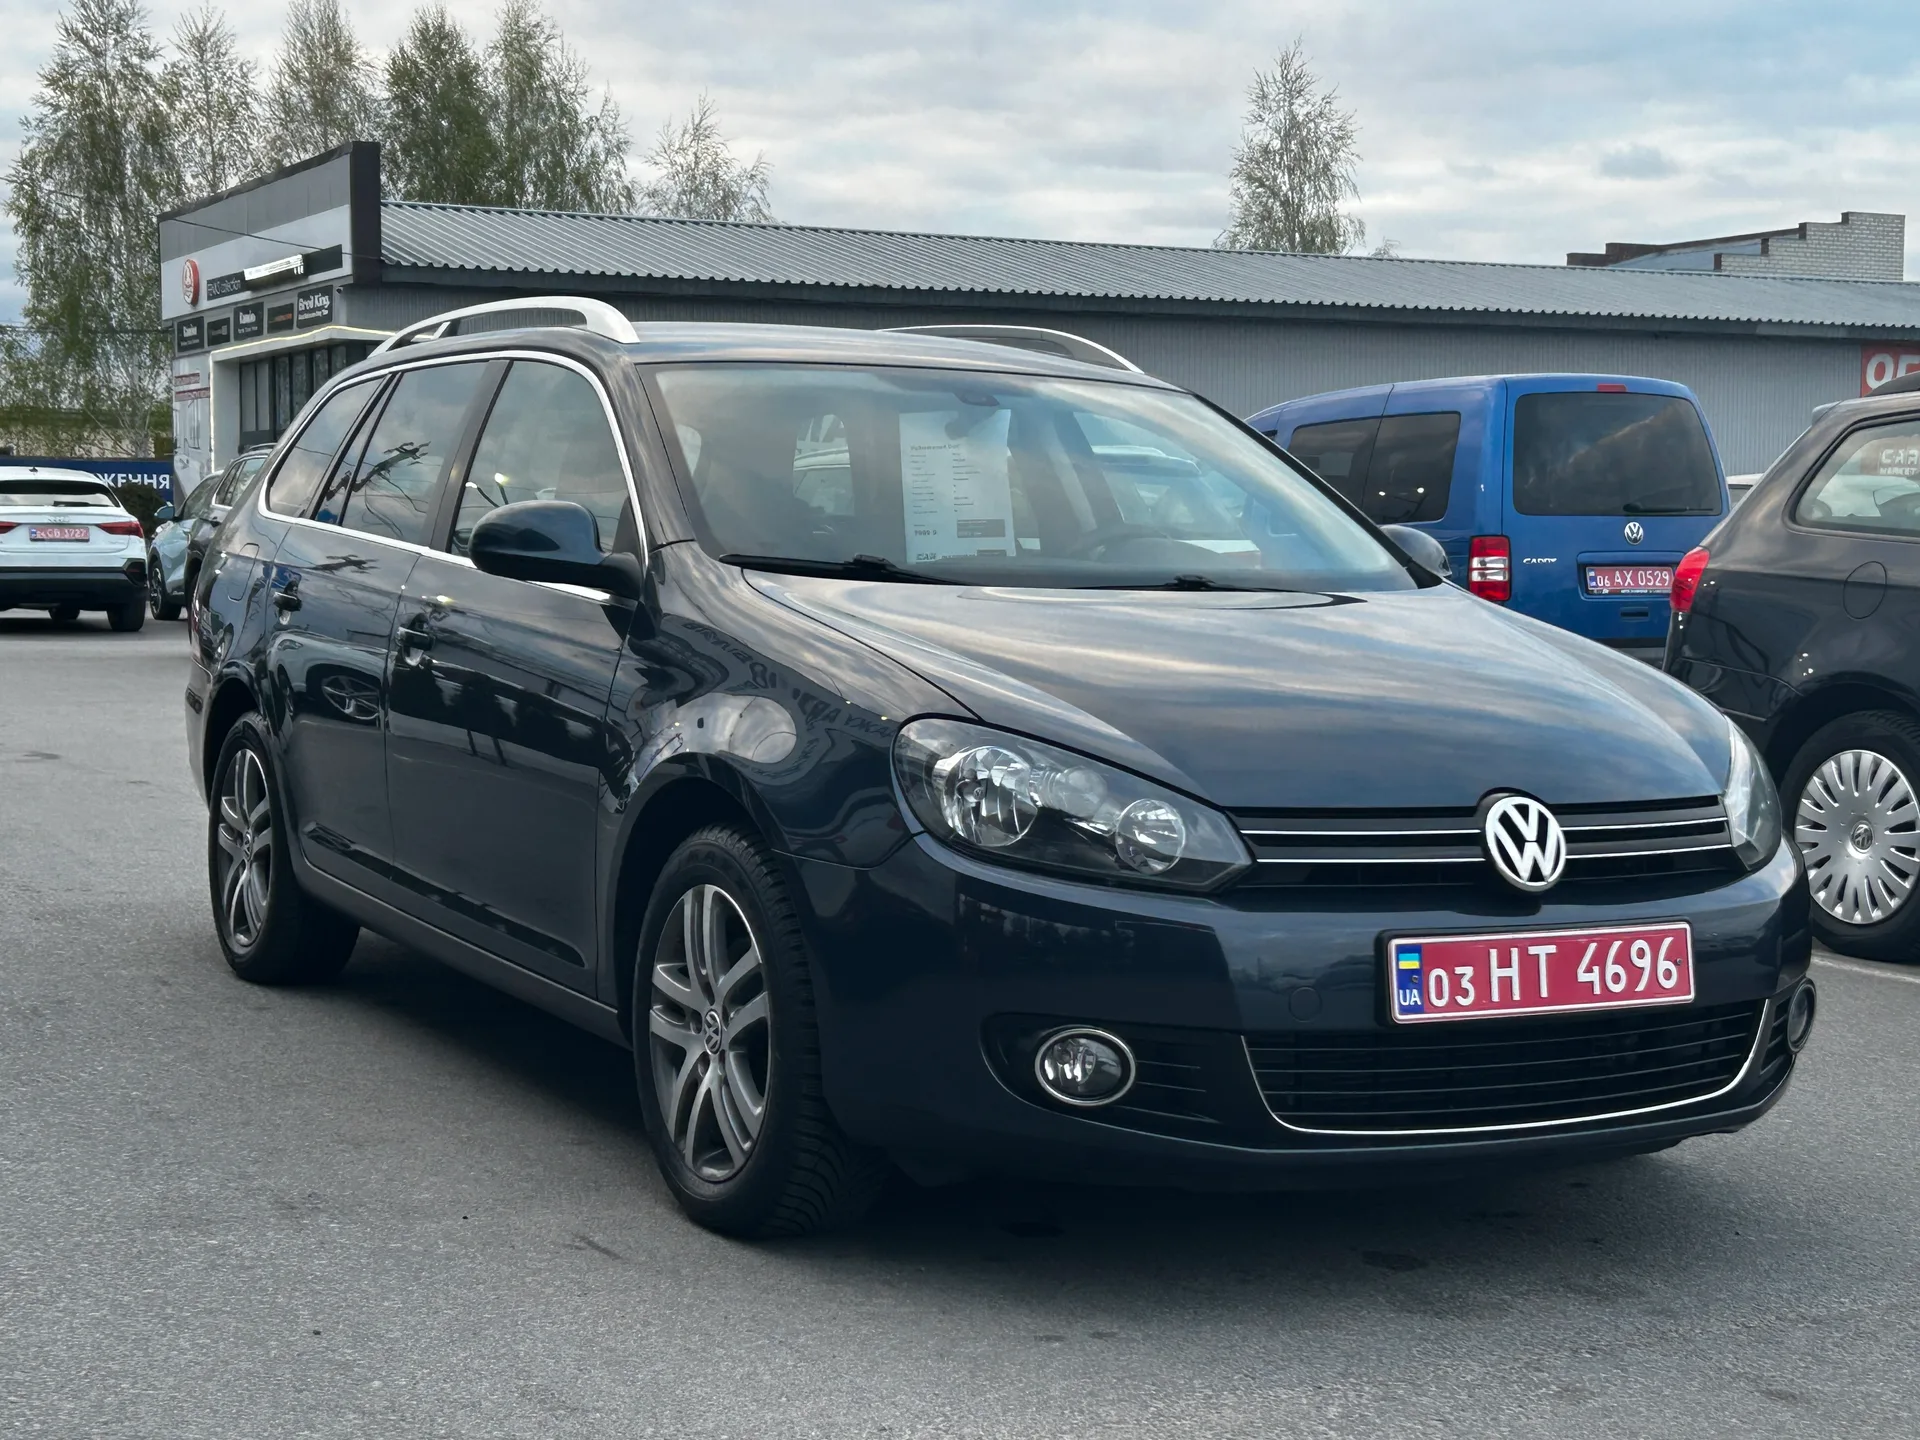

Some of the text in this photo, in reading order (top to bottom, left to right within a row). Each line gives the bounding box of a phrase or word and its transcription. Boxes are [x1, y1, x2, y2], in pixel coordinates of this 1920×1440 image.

[1596, 570, 1670, 587] 06 AX 0529
[1399, 936, 1679, 1007] UA 03 HT 4696
